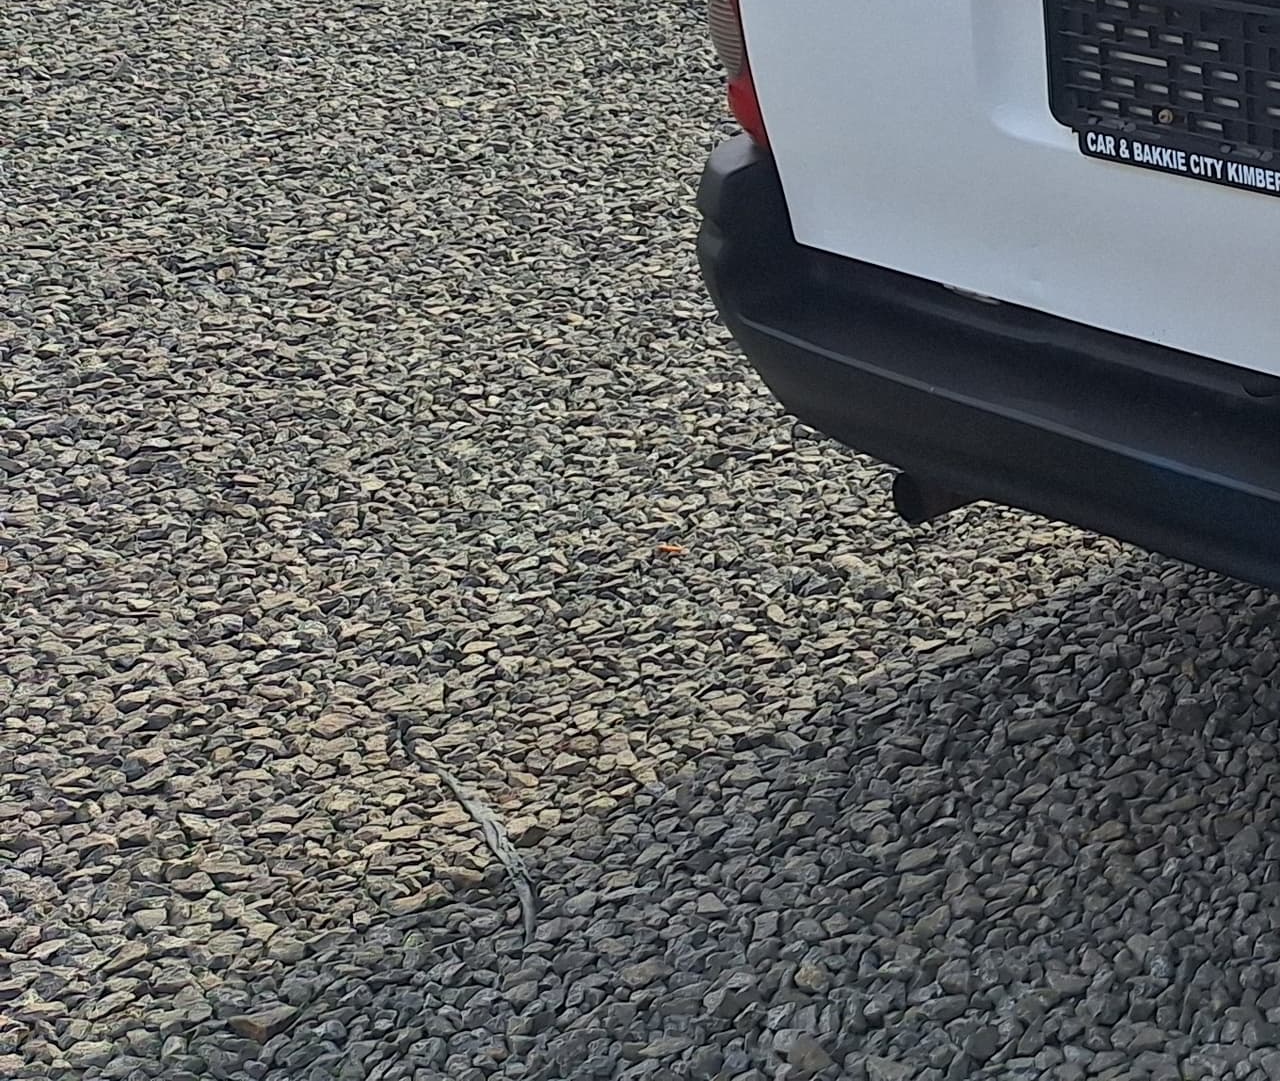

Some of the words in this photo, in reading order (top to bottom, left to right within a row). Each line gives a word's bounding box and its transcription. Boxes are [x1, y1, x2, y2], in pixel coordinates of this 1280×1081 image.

[1087, 132, 1115, 156] CAR
[1119, 142, 1130, 159] &
[1133, 141, 1187, 170] BAKKIE
[1190, 154, 1223, 179] CITY
